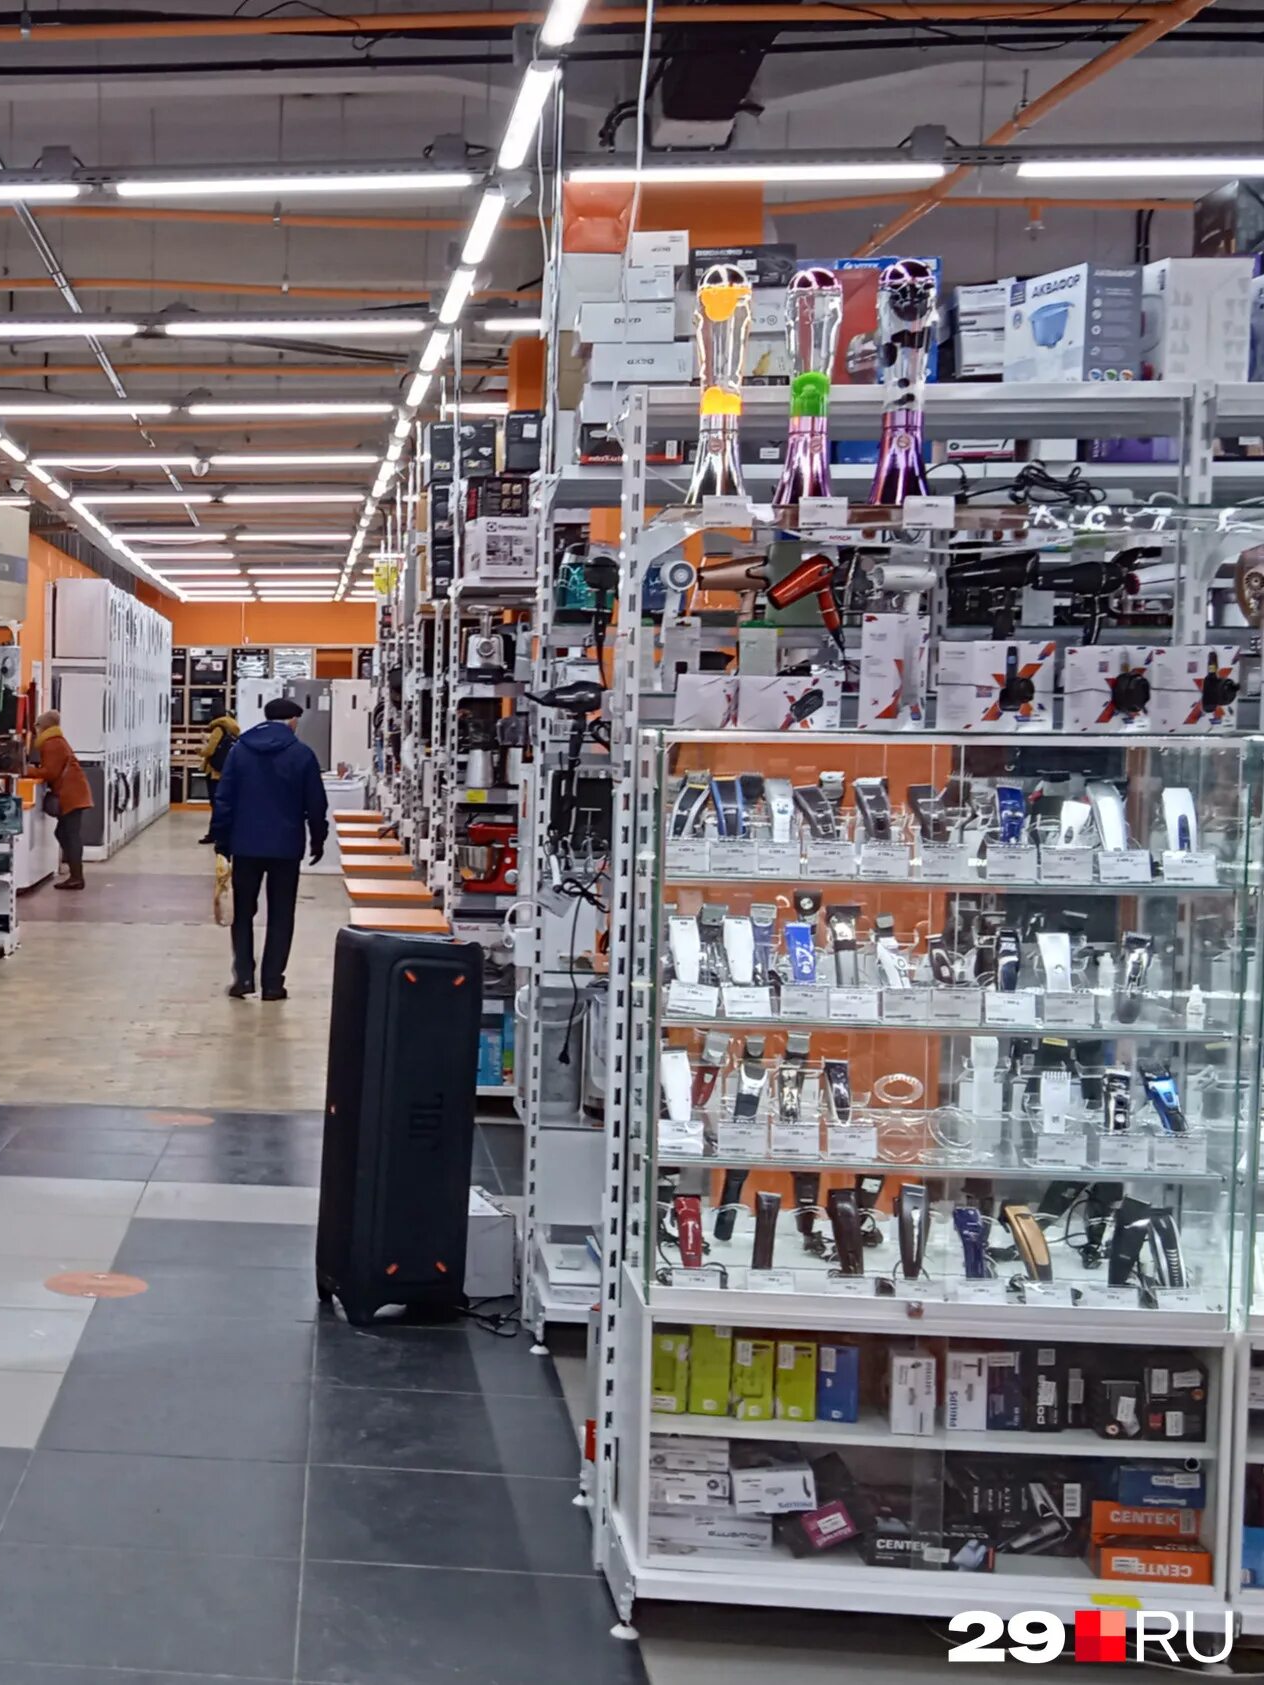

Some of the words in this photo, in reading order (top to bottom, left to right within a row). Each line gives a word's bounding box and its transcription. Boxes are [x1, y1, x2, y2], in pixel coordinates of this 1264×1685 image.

[1031, 274, 1081, 298] АКВАФОР
[949, 1390, 959, 1427] PHILIPS
[1110, 1510, 1177, 1526] CENTEK
[876, 1538, 930, 1551] CENTEK
[1137, 1563, 1193, 1577] CENTE
